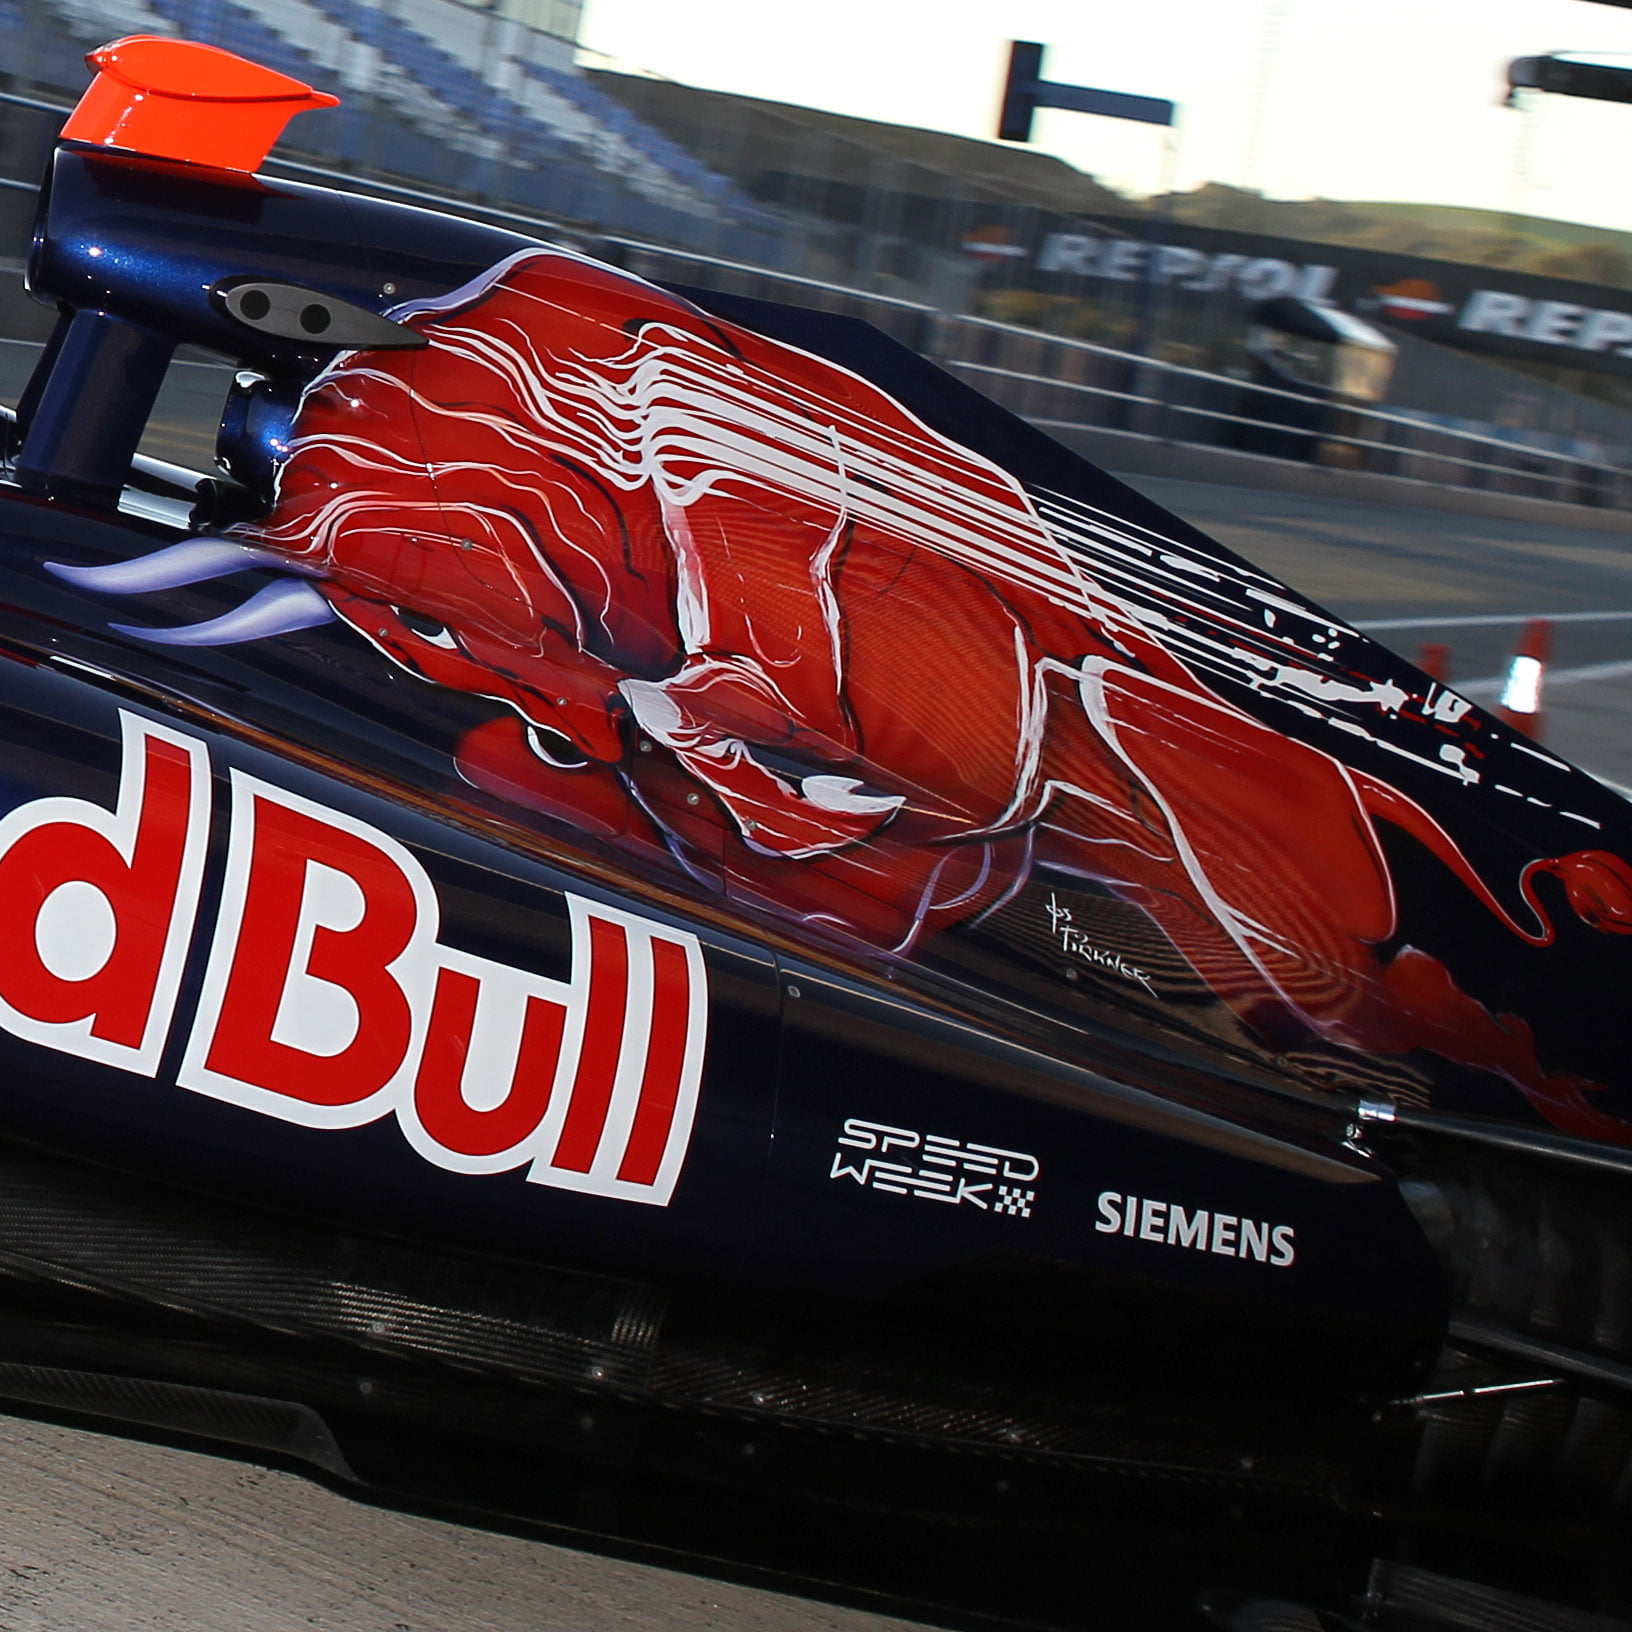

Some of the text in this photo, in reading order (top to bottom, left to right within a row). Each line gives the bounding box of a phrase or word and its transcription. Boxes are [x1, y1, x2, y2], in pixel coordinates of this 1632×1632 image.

[1038, 232, 1338, 304] REPSOL
[1457, 288, 1632, 358] REP
[176, 769, 709, 1206] Bull
[830, 1152, 993, 1210] WEEK
[838, 1118, 1039, 1181] SPEED
[1094, 1190, 1295, 1266] SIEMENS
